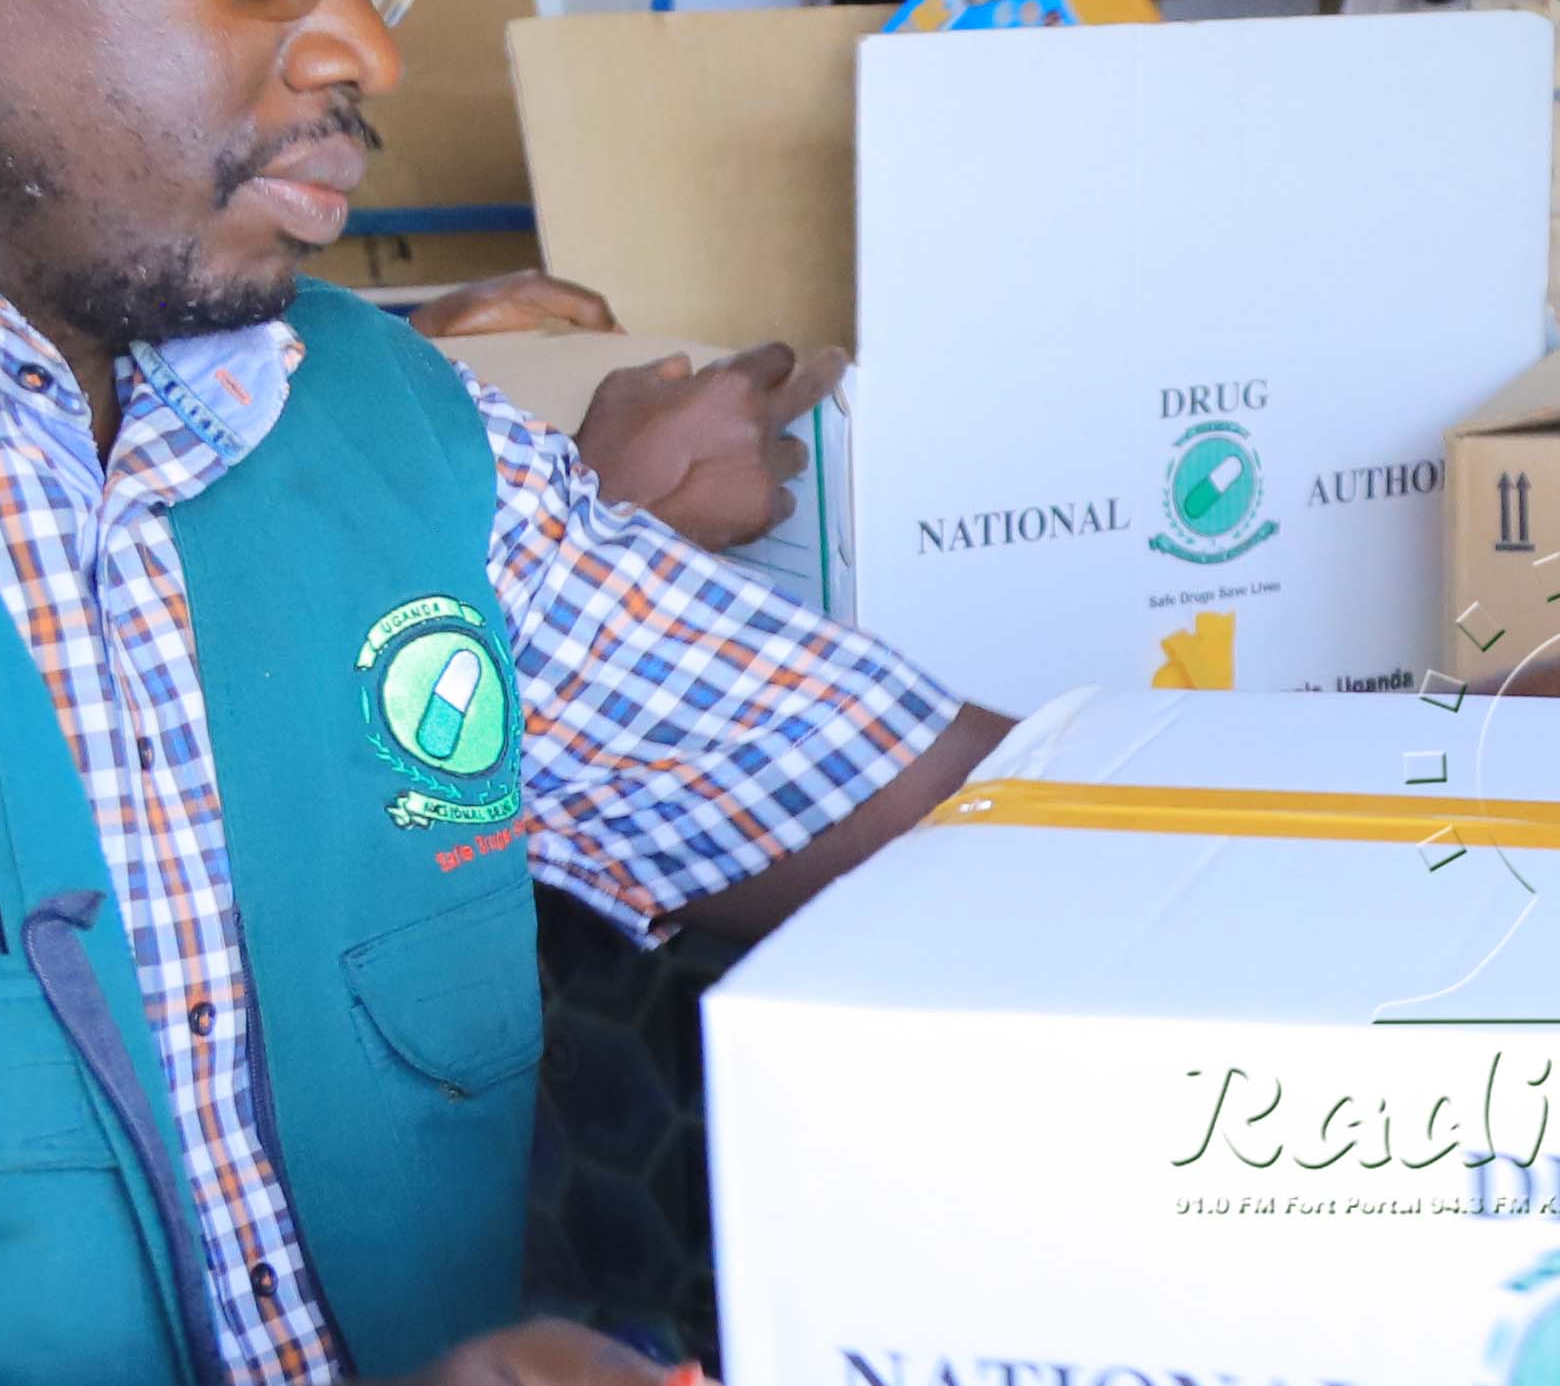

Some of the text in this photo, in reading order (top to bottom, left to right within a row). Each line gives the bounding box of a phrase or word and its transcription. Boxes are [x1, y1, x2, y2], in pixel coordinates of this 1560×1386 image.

[1159, 378, 1270, 419] DRUG
[916, 497, 1132, 557] NATIONAL
[382, 601, 441, 634] UGANDA
